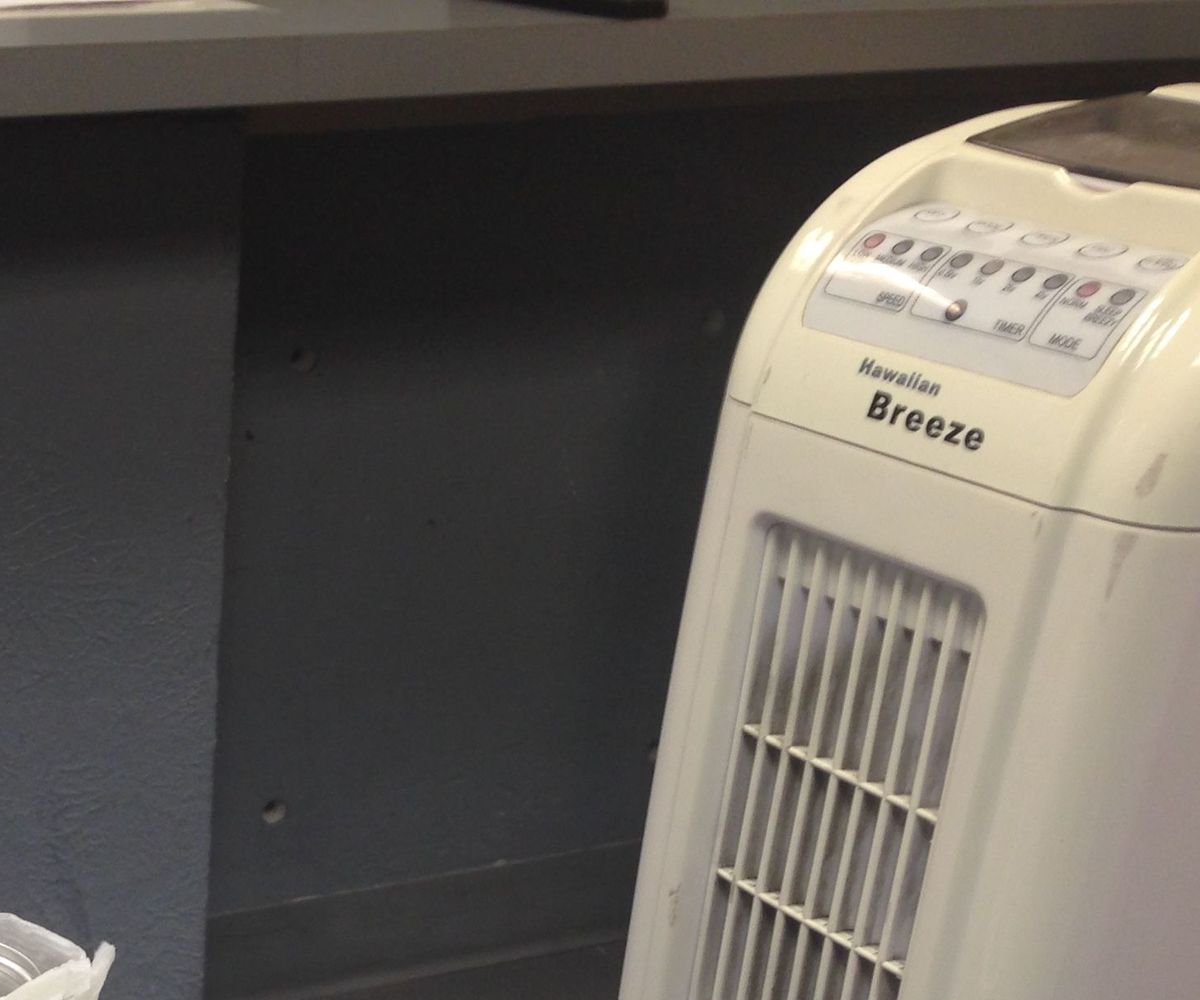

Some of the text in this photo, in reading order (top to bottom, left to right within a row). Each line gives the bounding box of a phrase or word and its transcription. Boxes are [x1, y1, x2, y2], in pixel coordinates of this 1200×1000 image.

[876, 291, 906, 307] SPEED
[993, 319, 1026, 336] TIMER
[1048, 333, 1083, 350] MODE
[858, 357, 941, 396] Hawaiian
[866, 389, 985, 451] Breeze
